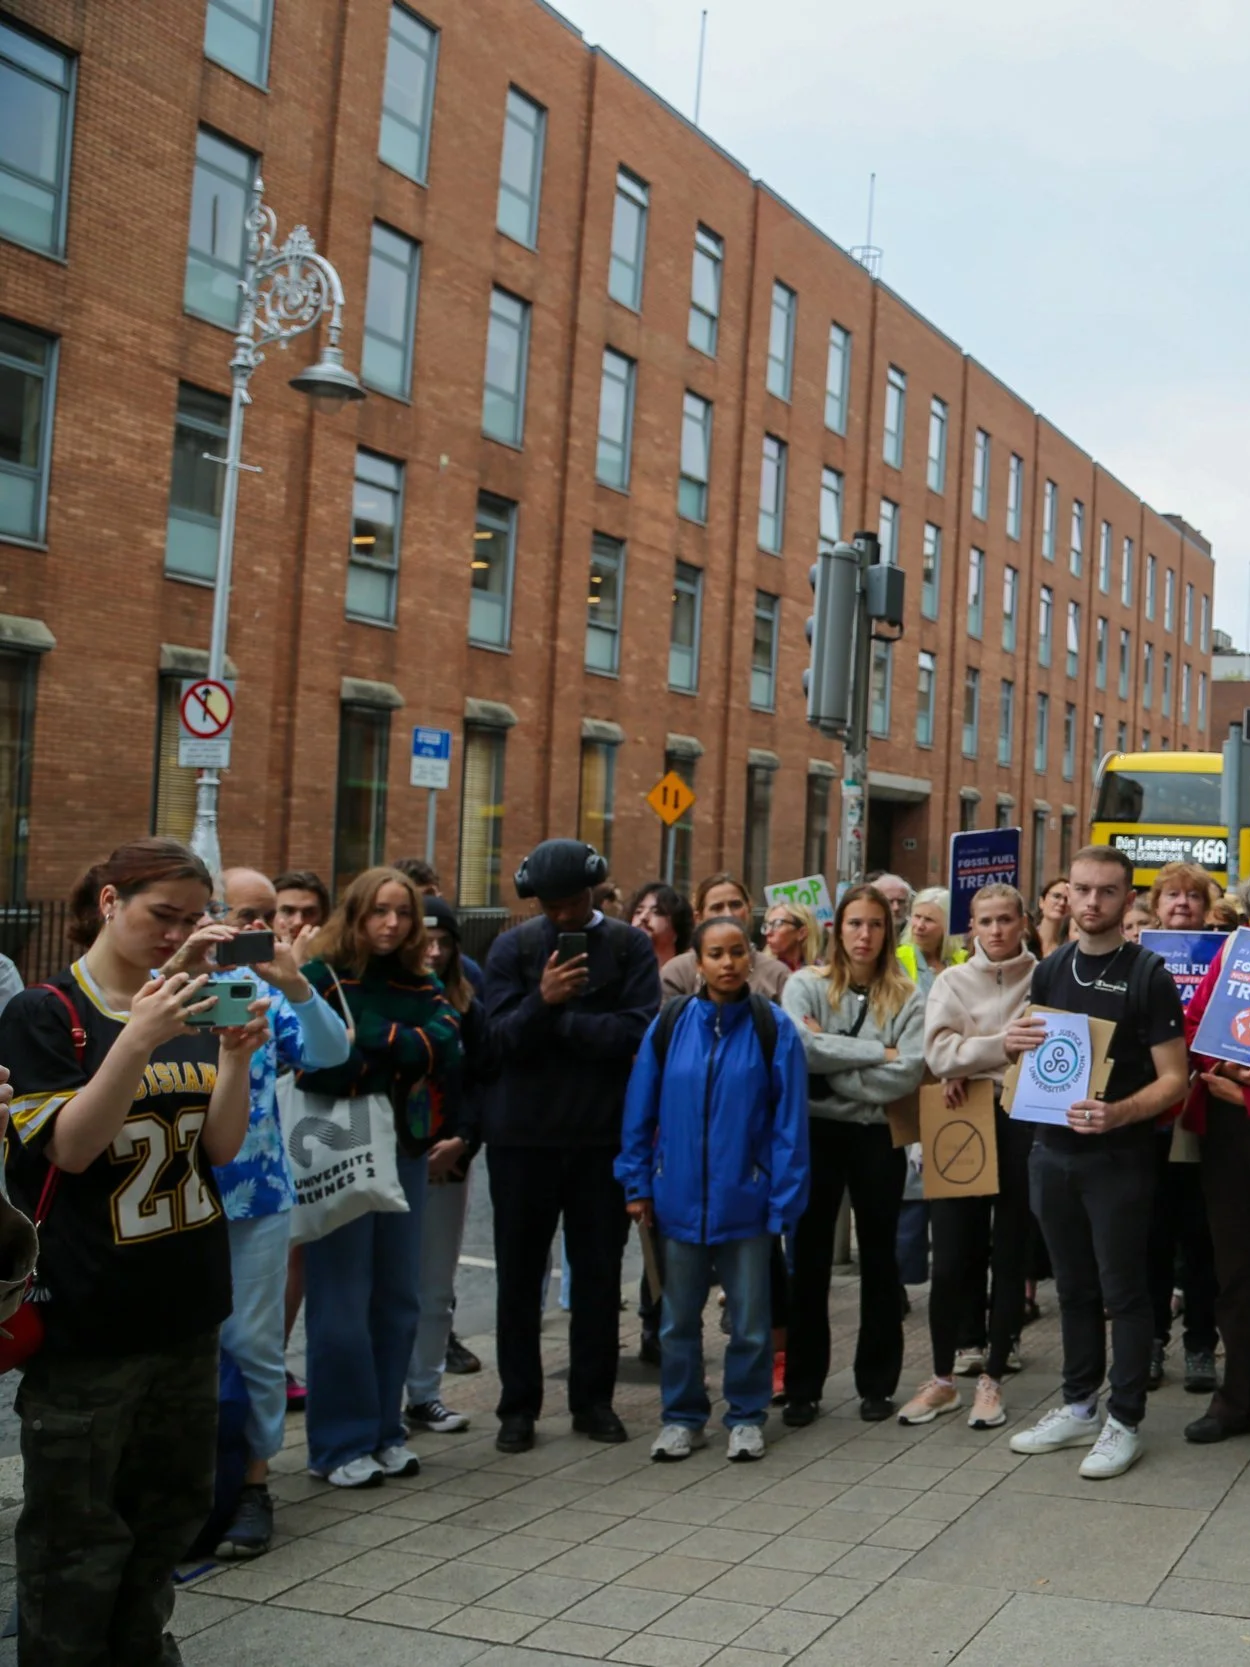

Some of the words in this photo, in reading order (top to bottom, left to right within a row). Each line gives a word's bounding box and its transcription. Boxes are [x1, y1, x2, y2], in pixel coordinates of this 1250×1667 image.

[1192, 839, 1227, 864] 46A
[958, 857, 990, 868] FOSSIL
[992, 854, 1016, 865] FUEL
[957, 871, 1016, 890] TREATY
[1163, 963, 1190, 975] SSIL
[1192, 963, 1210, 975] FU
[109, 1106, 221, 1244] 22
[366, 1167, 376, 1179] 2
